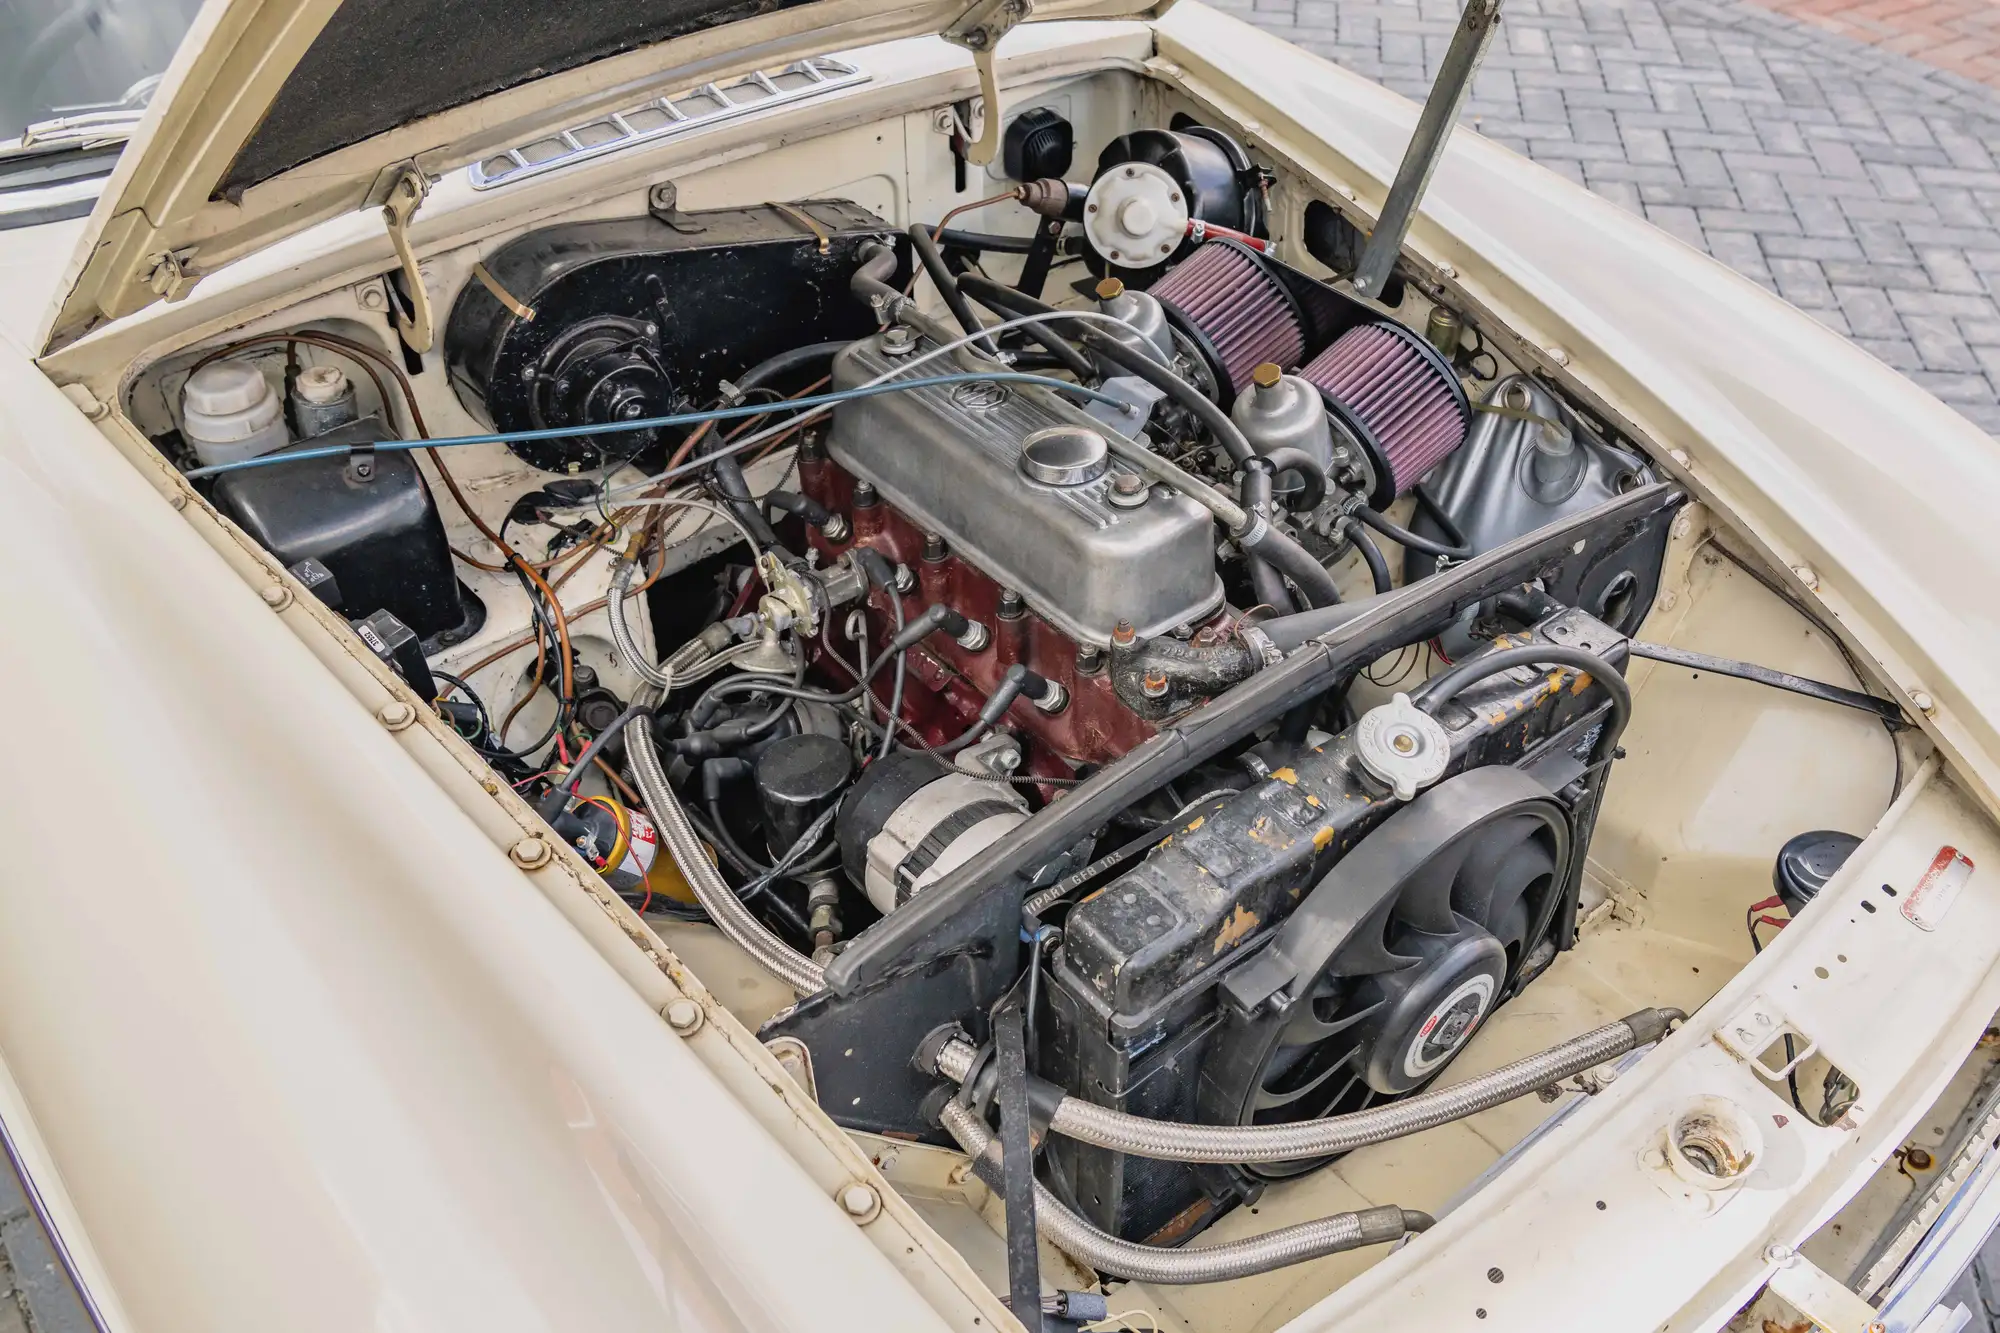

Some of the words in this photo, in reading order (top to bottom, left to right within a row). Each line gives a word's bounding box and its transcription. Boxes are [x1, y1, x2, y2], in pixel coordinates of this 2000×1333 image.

[954, 381, 1003, 408] MG
[1071, 866, 1097, 885] GFB
[1100, 851, 1123, 868] 103
